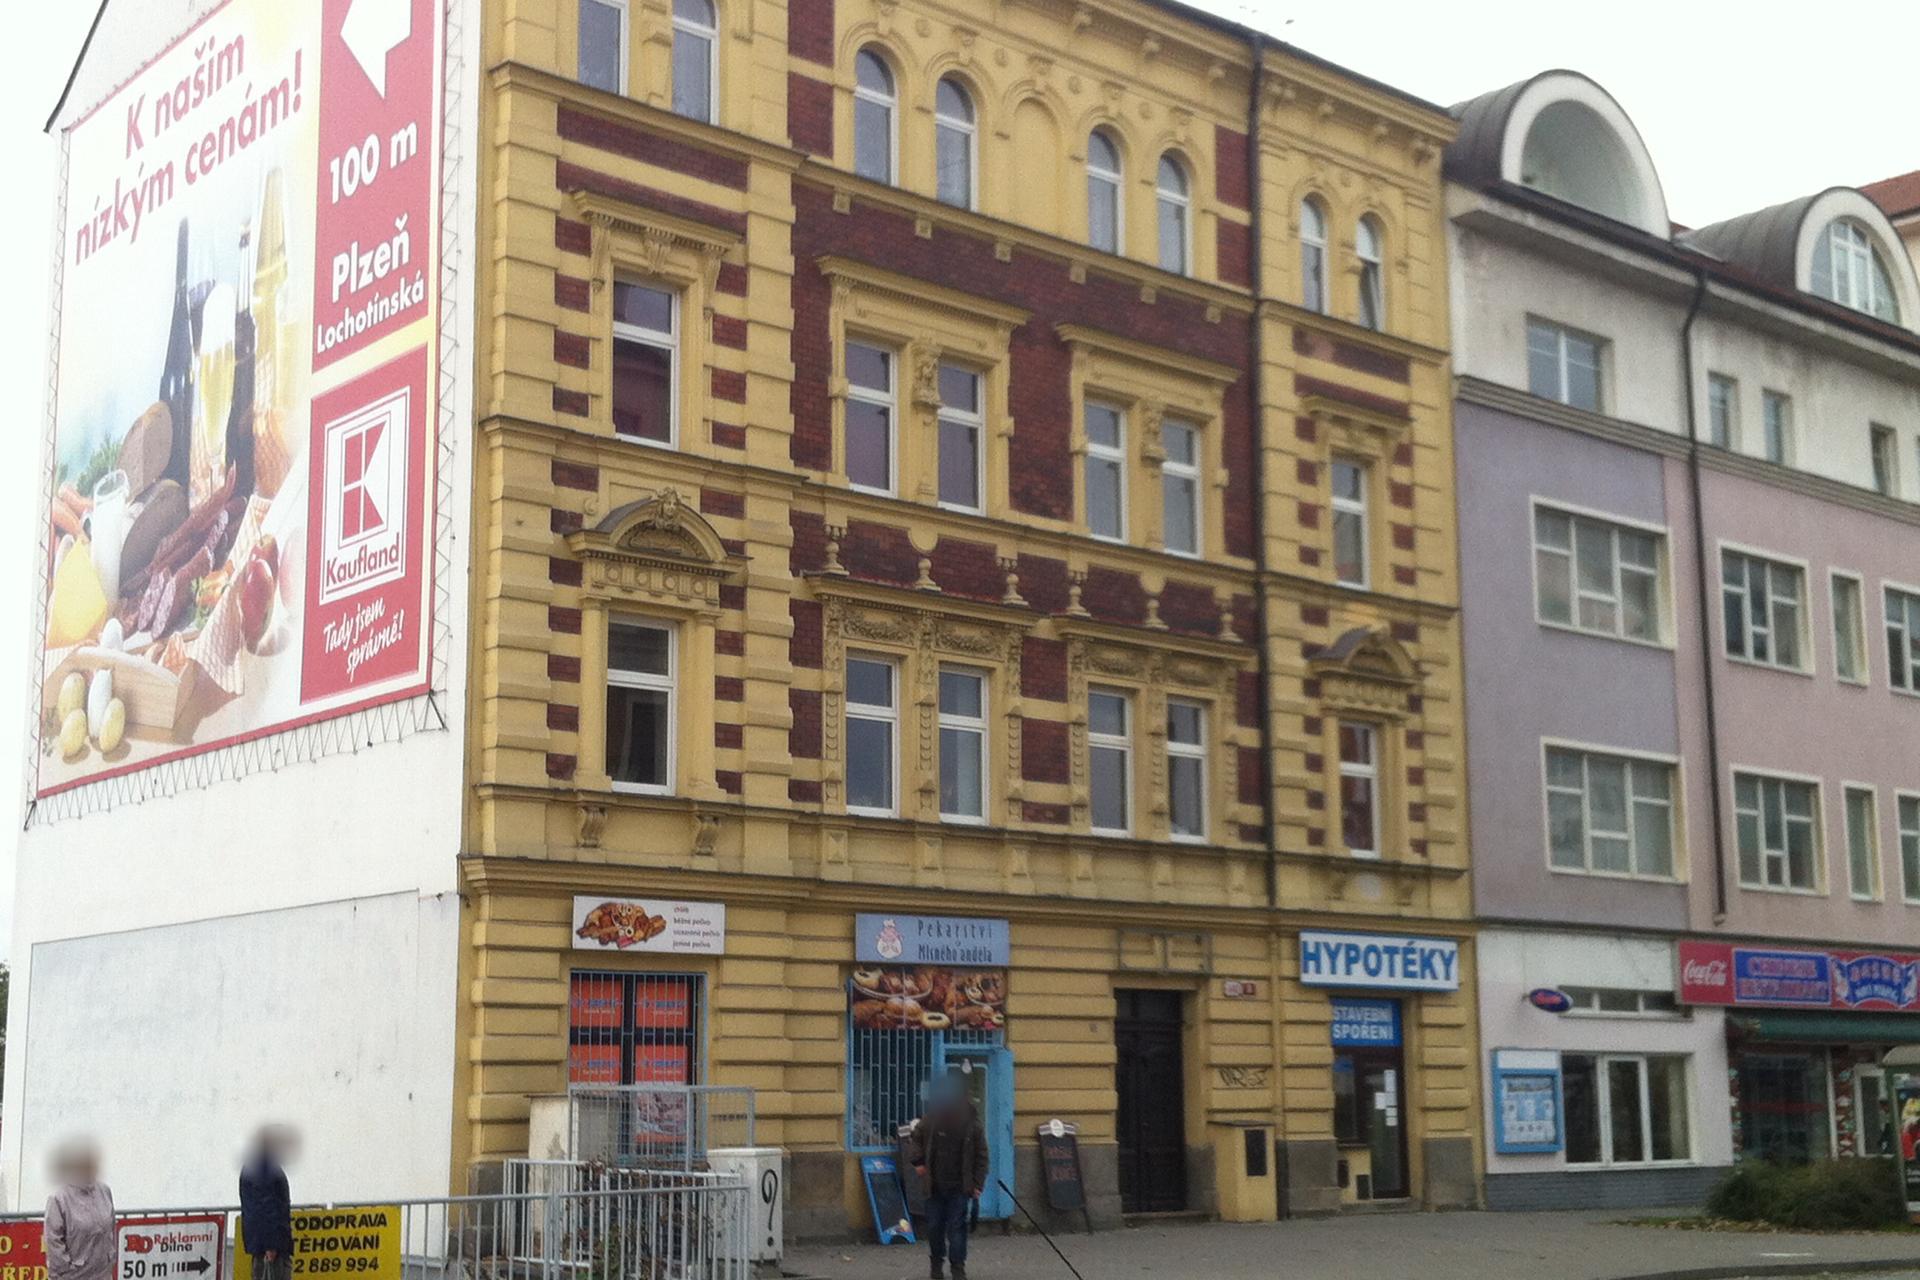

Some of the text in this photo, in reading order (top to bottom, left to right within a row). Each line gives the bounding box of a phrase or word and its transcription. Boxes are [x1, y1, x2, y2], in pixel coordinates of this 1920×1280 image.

[126, 34, 245, 160] K našim
[75, 48, 302, 267] nízkým cenám!
[330, 121, 417, 204] 100 m
[332, 212, 410, 304] Plzeň
[316, 269, 424, 354] Lochotínská
[326, 532, 400, 588] Kaufland
[323, 597, 386, 655] Tady jsem
[346, 609, 405, 683] správně!
[1302, 941, 1456, 981] HYPOTÉKY
[123, 1260, 167, 1279] 50 m
[309, 1257, 341, 1273] 889
[346, 1257, 379, 1272] 994
